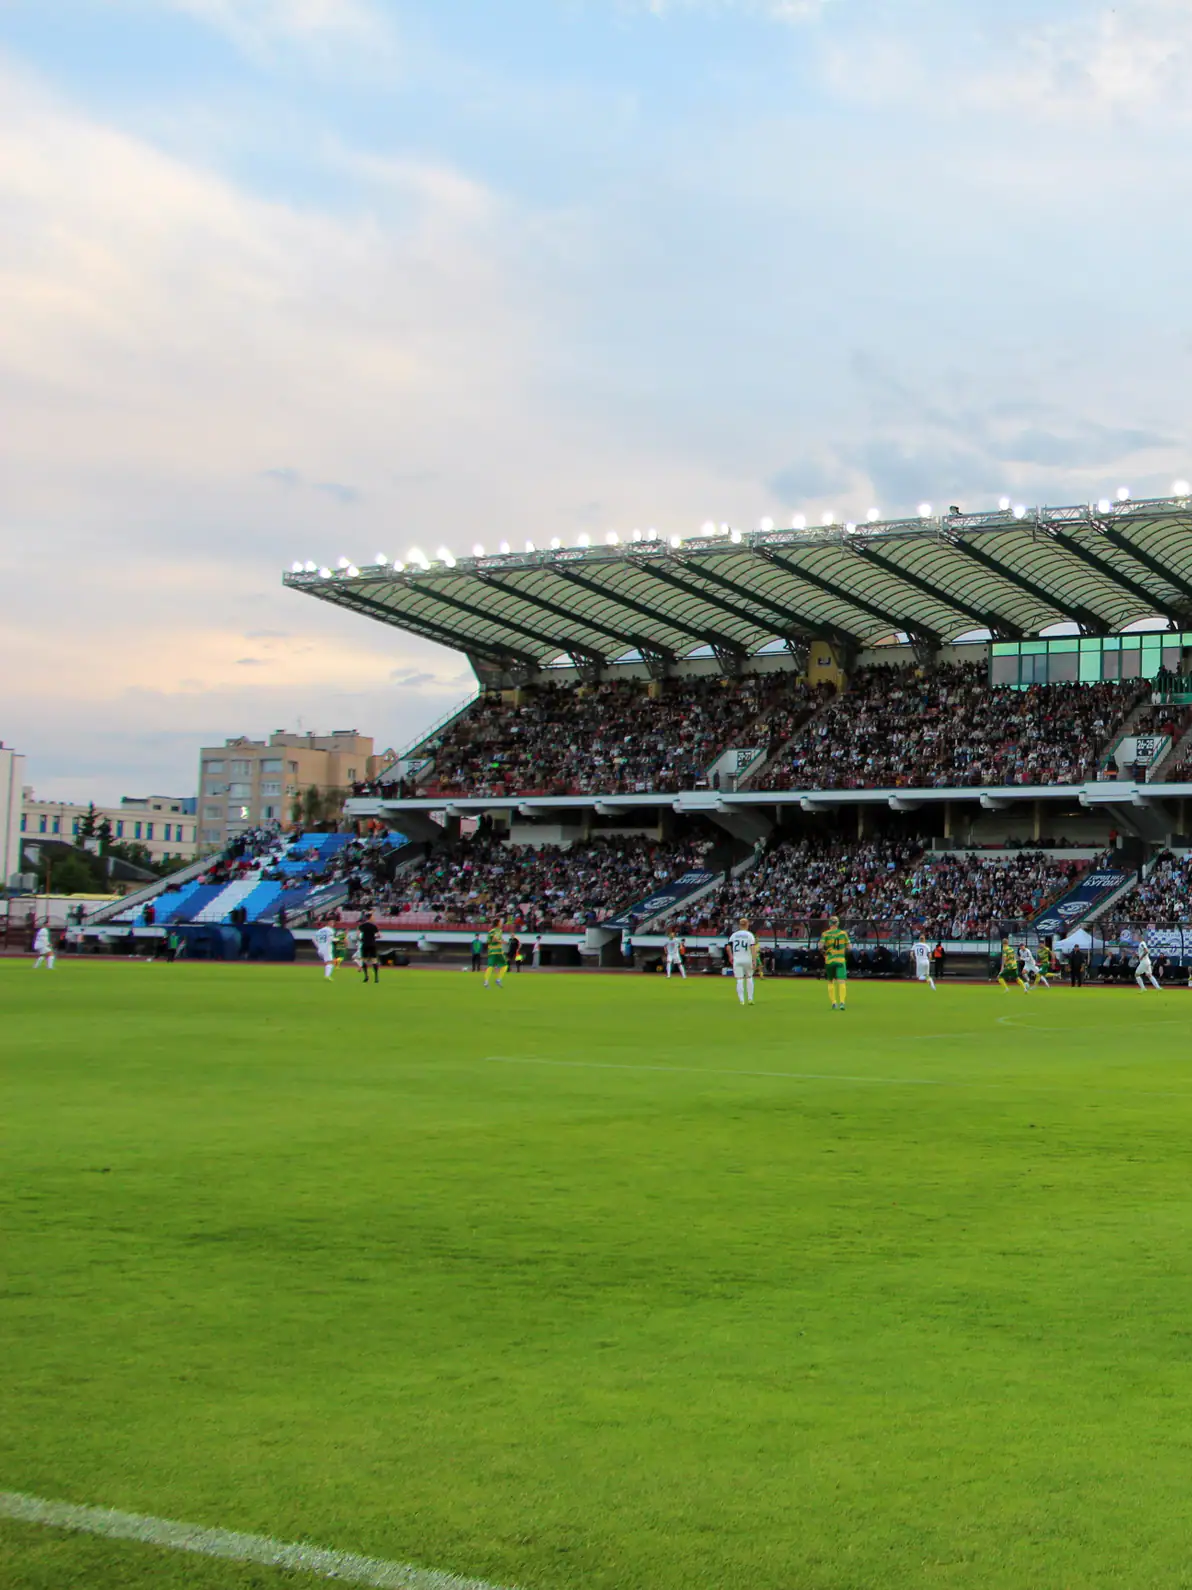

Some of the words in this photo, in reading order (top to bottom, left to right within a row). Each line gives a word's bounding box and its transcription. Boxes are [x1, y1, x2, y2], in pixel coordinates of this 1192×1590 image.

[1137, 740, 1154, 749] 26-25
[734, 940, 748, 952] 24
[917, 948, 924, 956] 19
